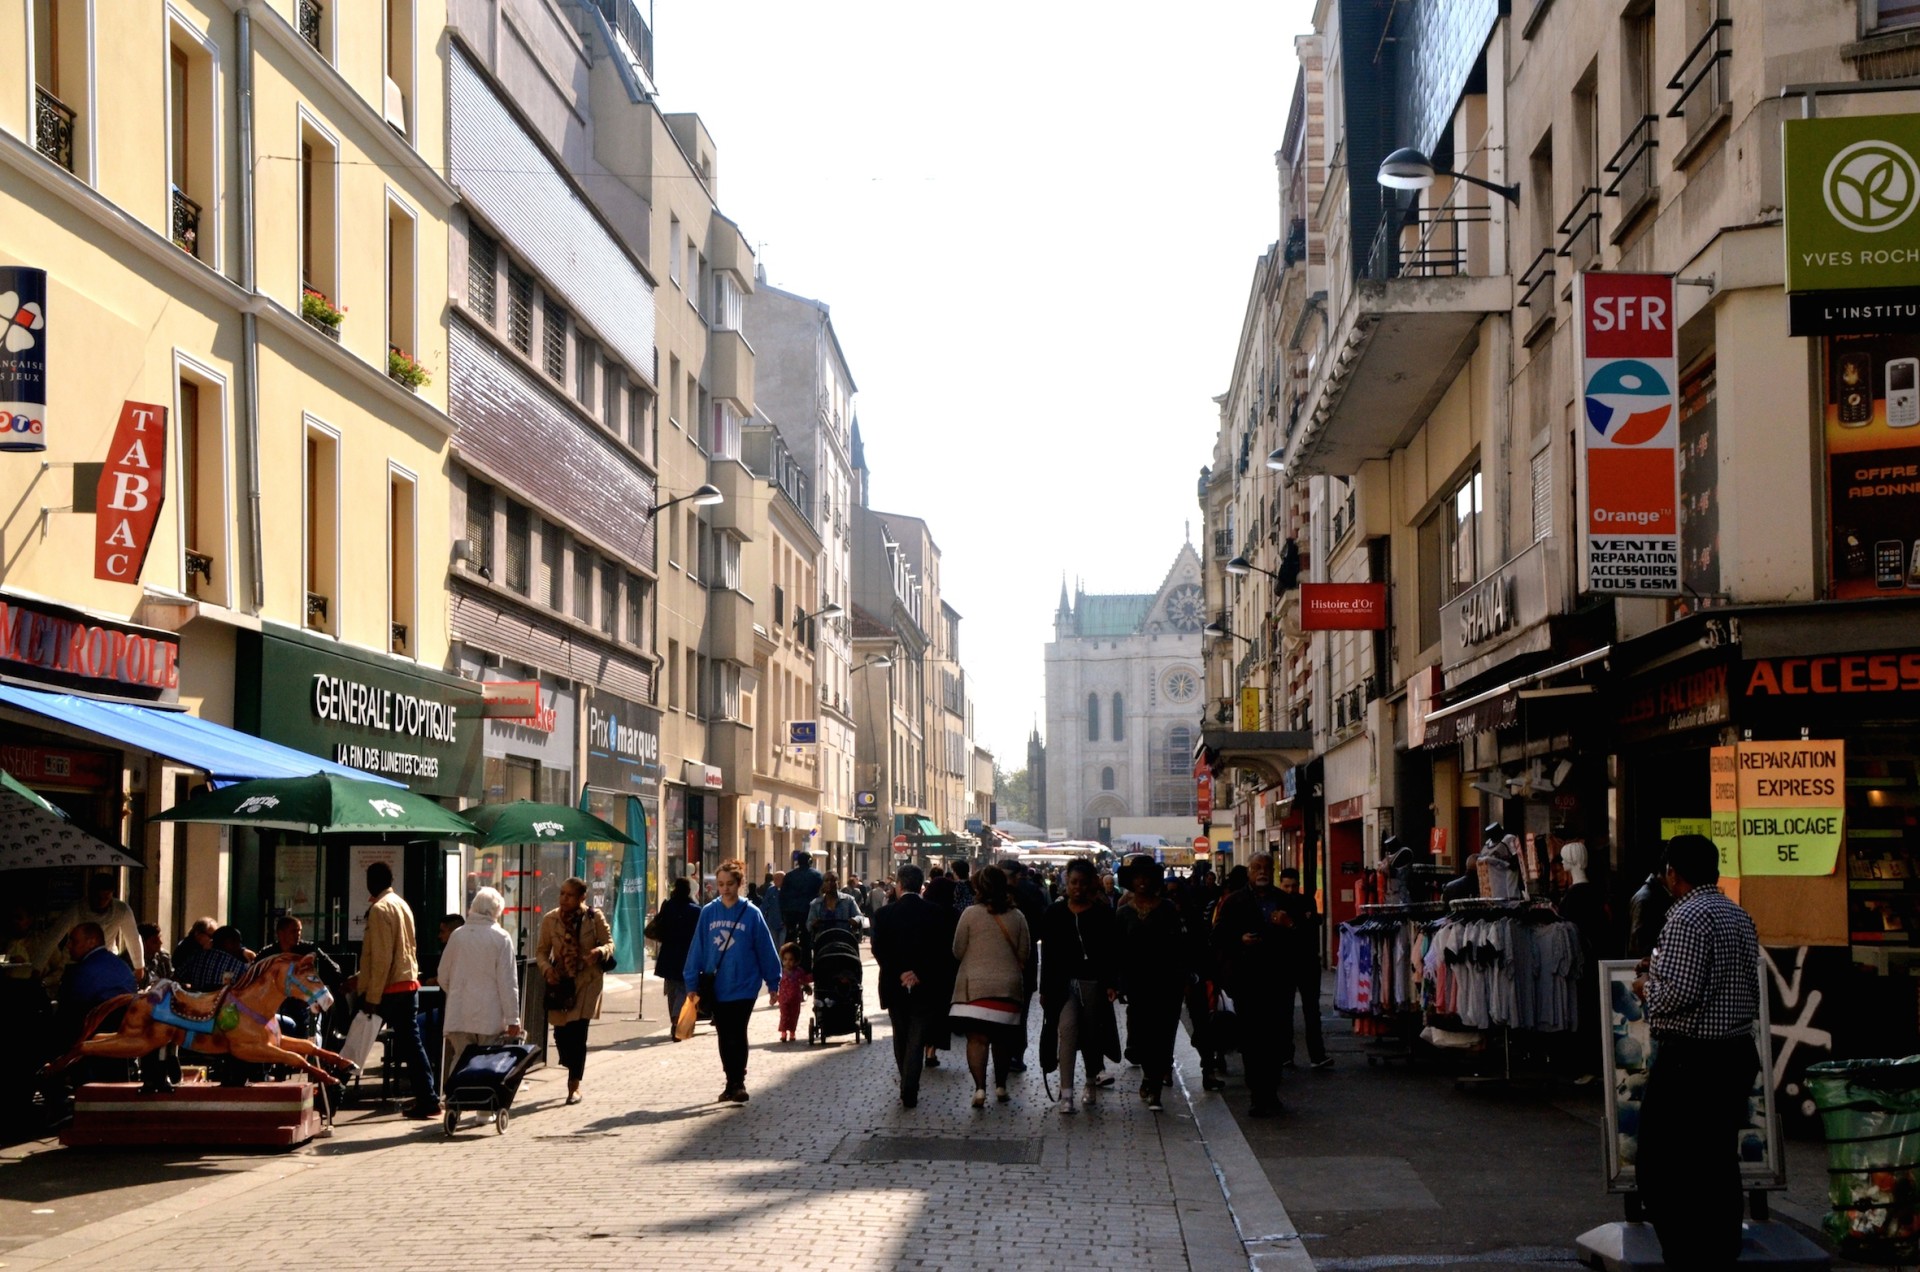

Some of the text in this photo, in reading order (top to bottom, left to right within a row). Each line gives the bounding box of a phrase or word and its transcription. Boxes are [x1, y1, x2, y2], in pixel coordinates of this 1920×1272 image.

[1802, 248, 1920, 267] YVES ROCH
[1592, 296, 1667, 331] SFR
[1824, 304, 1920, 320] L'INSTITU
[0, 359, 44, 371] NÇAISE
[10, 372, 40, 382] JEUX
[1855, 464, 1919, 481] OFFRE
[105, 409, 154, 577] TABAC
[1593, 508, 1660, 525] Orange
[1591, 540, 1677, 551] VENTE
[1591, 553, 1677, 563] REPARATION
[1591, 565, 1677, 576] ACCESSOIRES
[1591, 578, 1677, 589] TOUS GSM
[1311, 598, 1374, 609] Histoire d'Or
[0, 601, 178, 689] METROPOLE
[1745, 654, 1920, 697] ACCESS
[1659, 662, 1728, 715] FACTORY
[314, 673, 457, 743] GENERALE D'OPTIQUE
[590, 706, 609, 748] Prix
[617, 724, 657, 767] marque
[791, 727, 812, 736] LCL
[338, 743, 439, 778] LA FIN DES LUNETTES CHERES
[1740, 751, 1836, 769] REPARATION
[1758, 779, 1835, 797] EXPRESS
[1743, 817, 1837, 836] DEBLOCAGE
[1777, 844, 1800, 862] 5E
